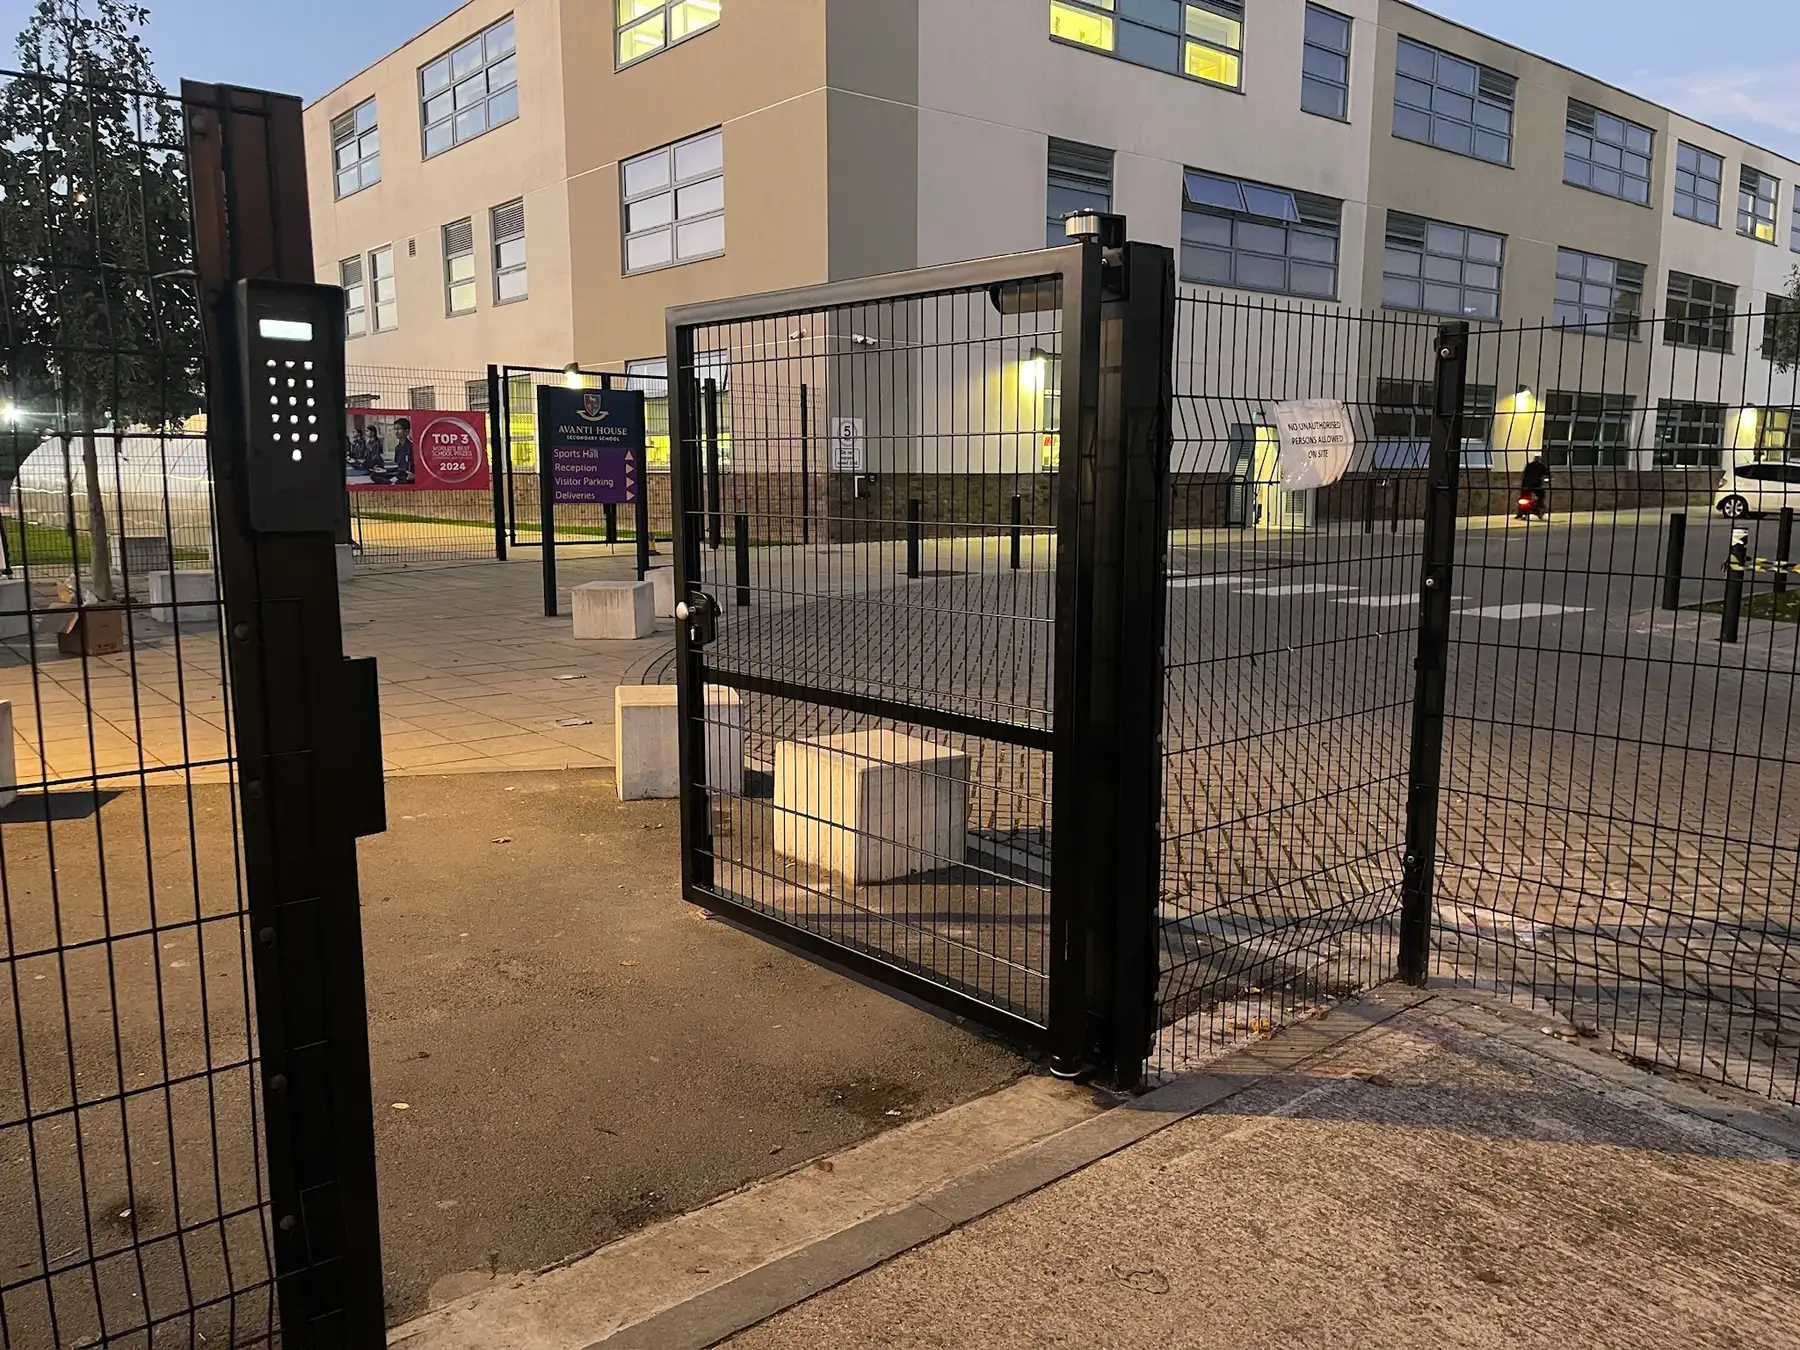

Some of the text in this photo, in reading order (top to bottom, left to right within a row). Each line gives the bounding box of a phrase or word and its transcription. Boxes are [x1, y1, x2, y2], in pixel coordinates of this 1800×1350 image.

[559, 425, 627, 435] AVANTI HOUSE
[1288, 421, 1341, 431] NO UNAUTHORISED
[844, 426, 851, 436] 5
[432, 434, 469, 444] TOP 3
[1292, 435, 1343, 444] PERSONS ALLOWED
[554, 449, 598, 458] Sports Hall
[1308, 450, 1317, 458] ON
[555, 464, 597, 472] Reception
[555, 478, 614, 488] Visitor Parking
[556, 491, 595, 500] Deliveries
